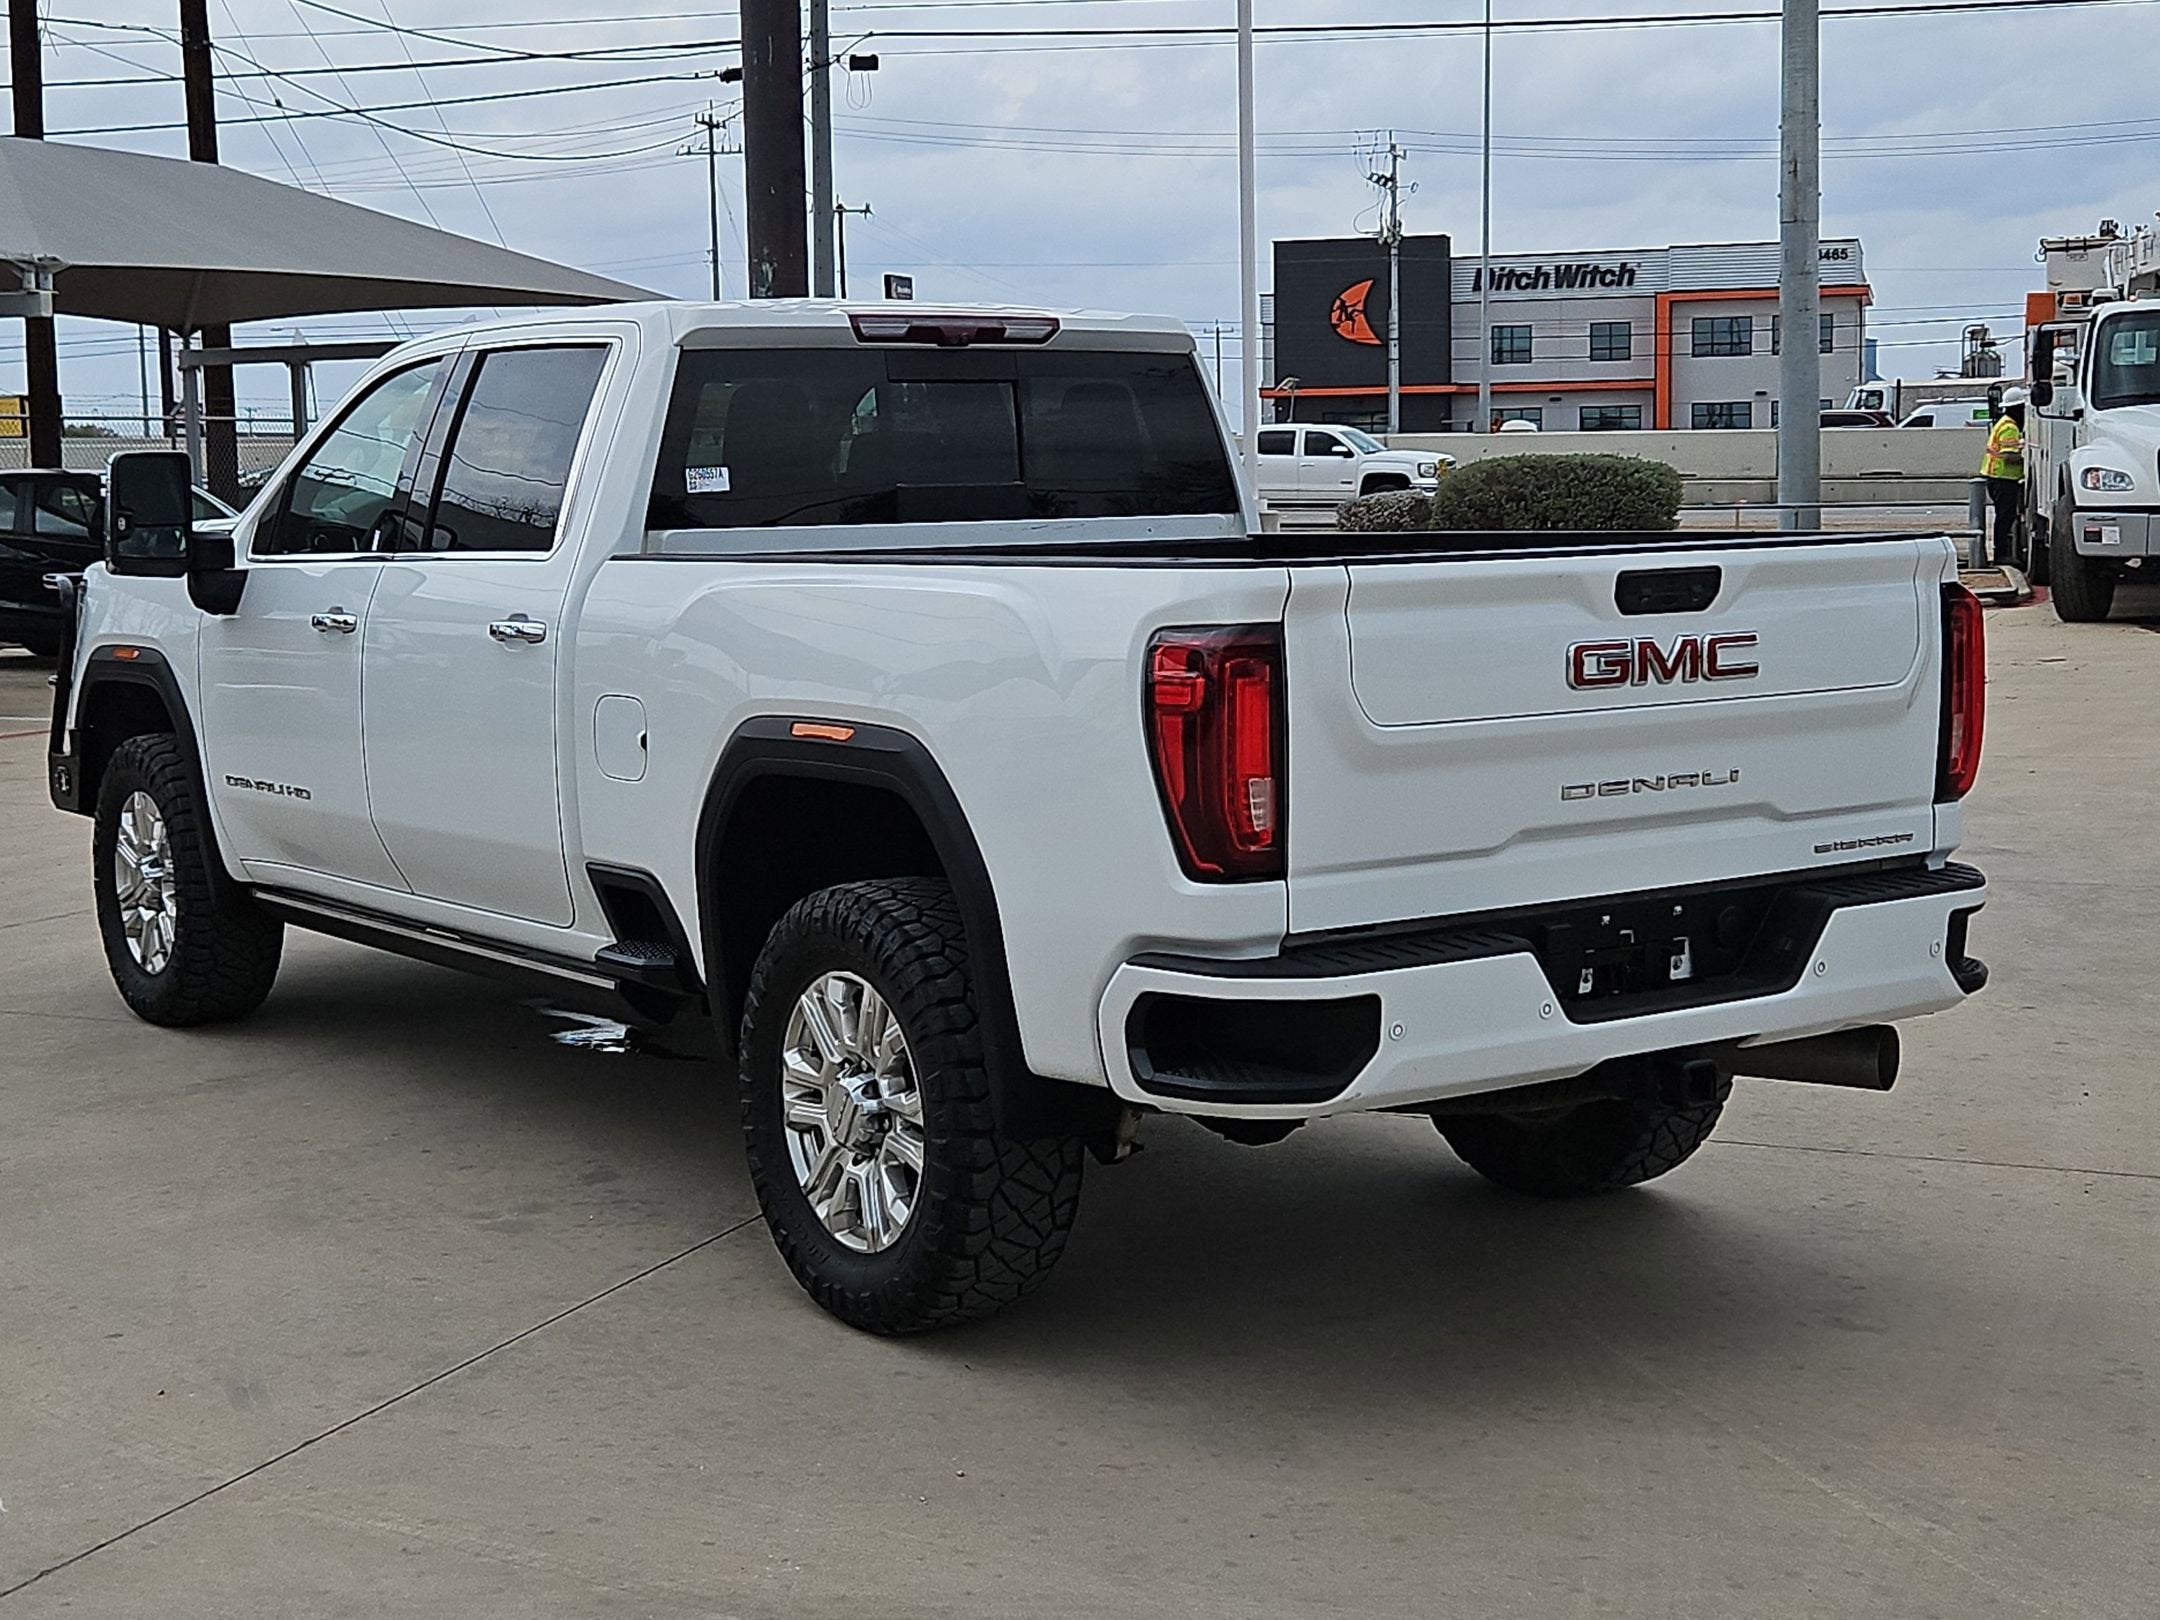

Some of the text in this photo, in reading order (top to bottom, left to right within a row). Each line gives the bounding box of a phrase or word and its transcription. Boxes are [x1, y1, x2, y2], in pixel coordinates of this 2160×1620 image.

[1472, 262, 1637, 292] Ditch Witch
[1566, 630, 1760, 691] GMC
[1561, 768, 1740, 801] DENALI
[1814, 833, 1914, 854] SIERRA
